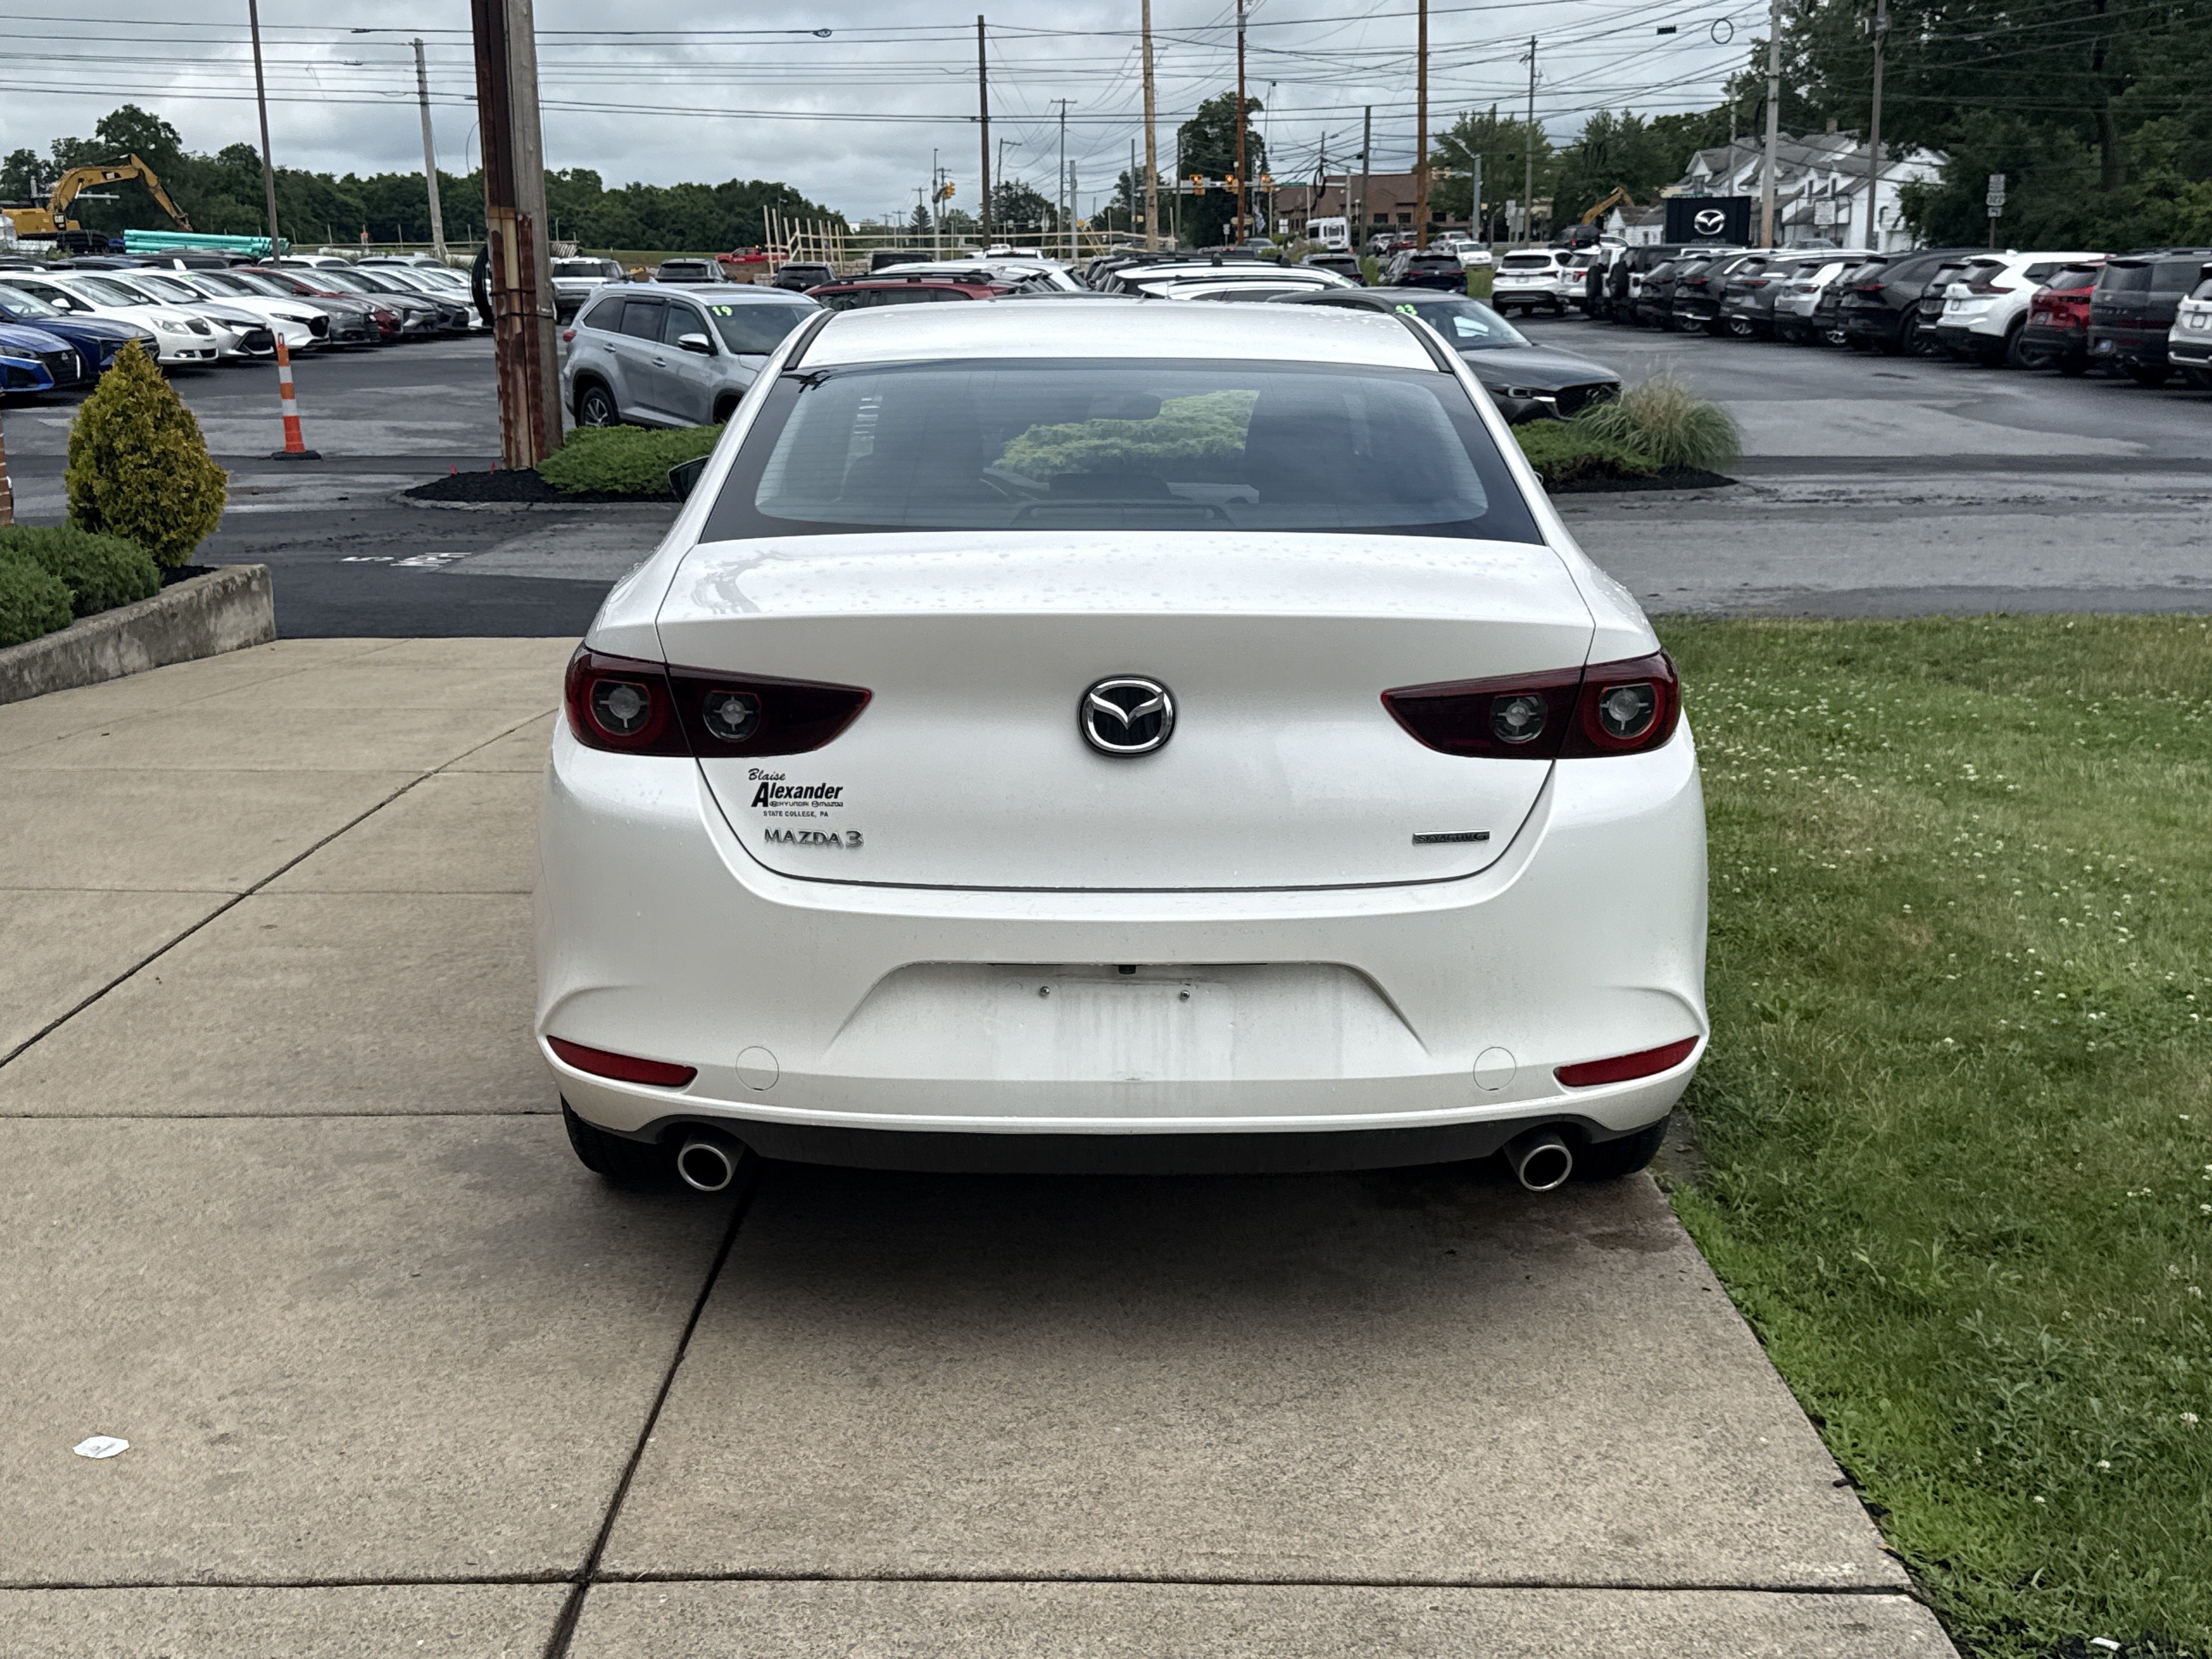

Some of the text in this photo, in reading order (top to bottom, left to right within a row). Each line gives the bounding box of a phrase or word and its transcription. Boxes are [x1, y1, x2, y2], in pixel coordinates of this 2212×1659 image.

[712, 306, 733, 317] 19
[748, 768, 786, 781] Blaise
[751, 782, 843, 807] Alexander
